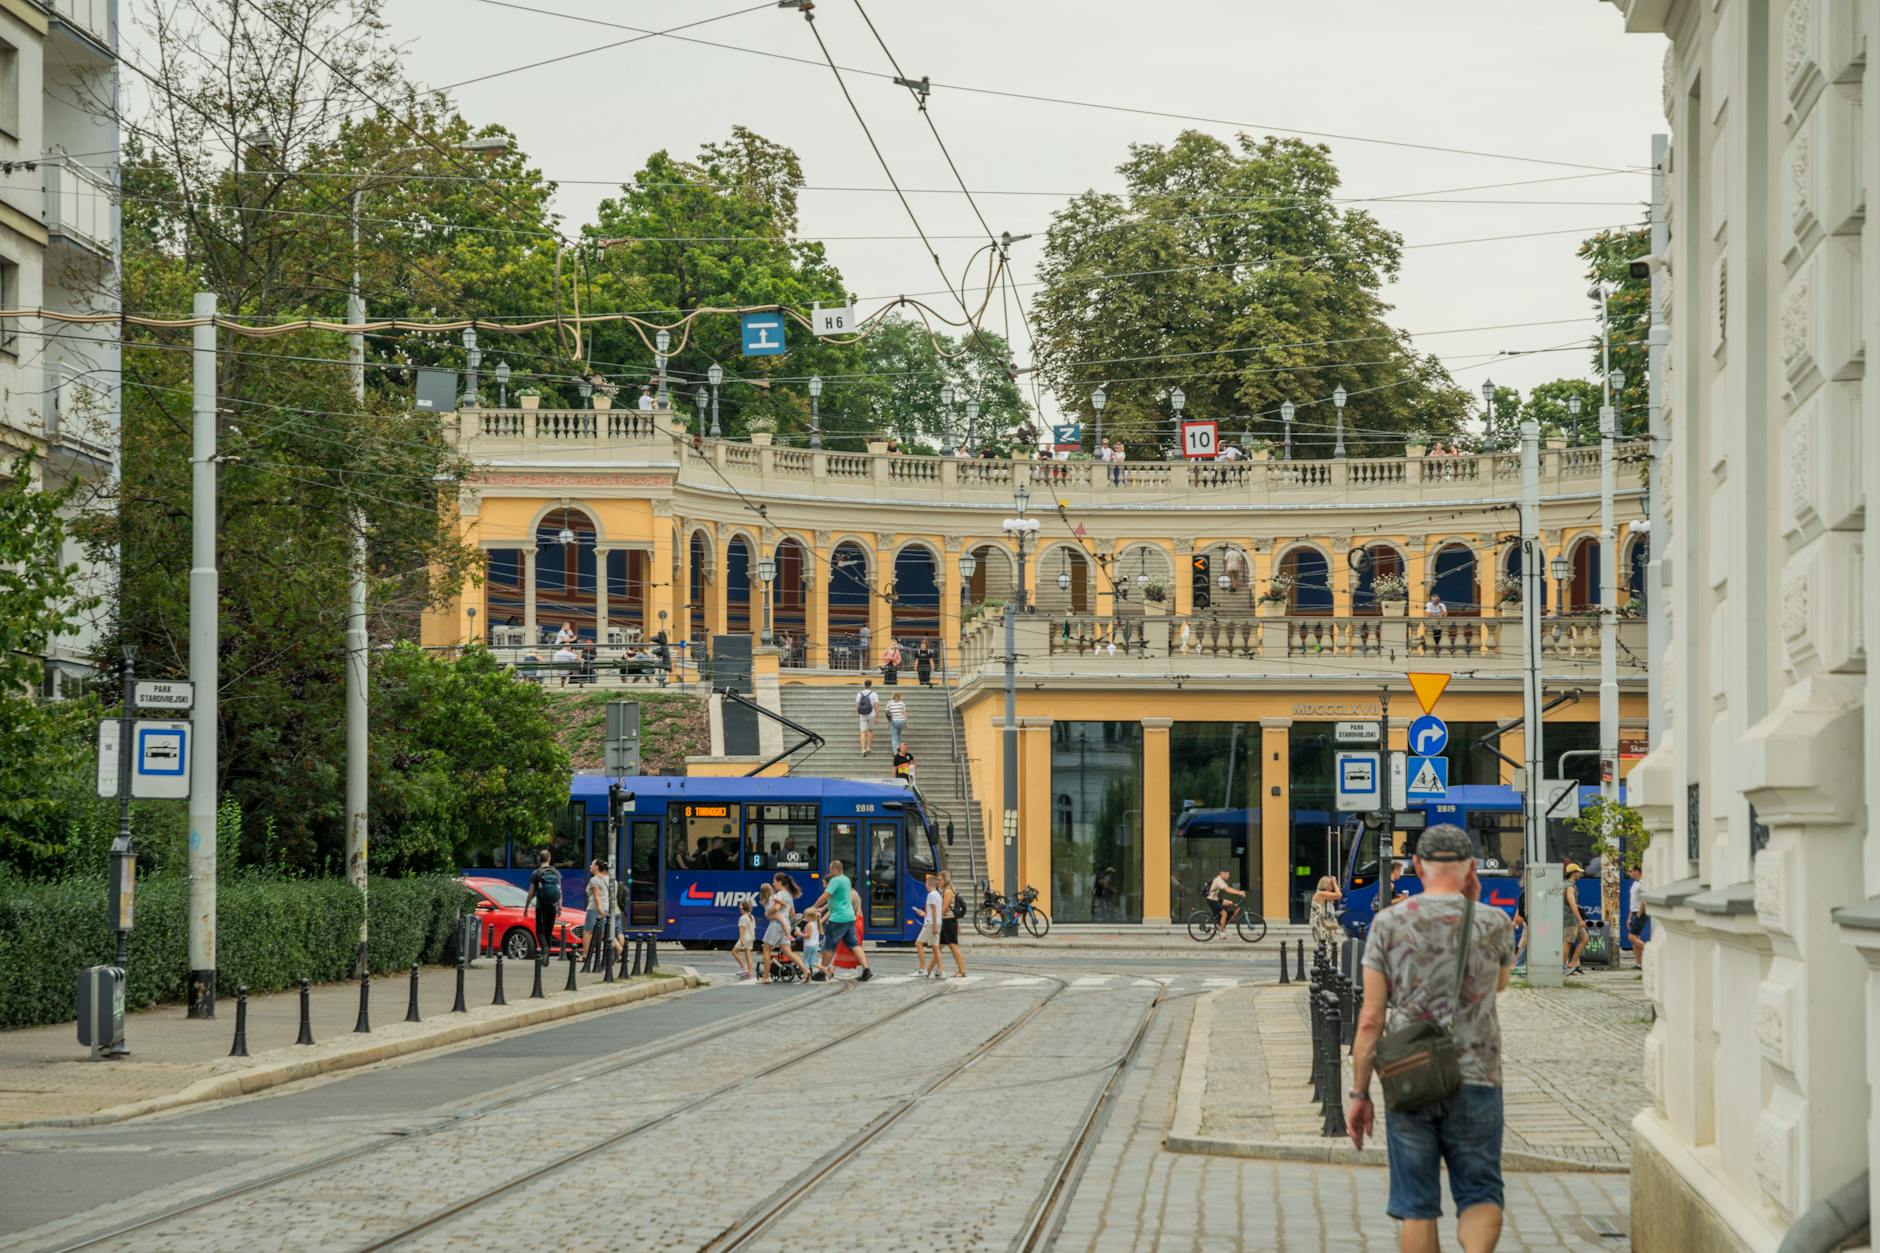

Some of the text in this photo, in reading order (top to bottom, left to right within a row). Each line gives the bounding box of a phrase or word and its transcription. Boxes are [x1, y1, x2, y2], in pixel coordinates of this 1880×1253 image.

[825, 316, 844, 330] H 6
[1189, 431, 1210, 449] 10
[153, 685, 172, 693] PARK
[140, 694, 189, 703] STAROMIEJSKI
[684, 806, 692, 817] 8
[855, 804, 875, 813] 2818
[1436, 804, 1456, 813] 2819
[753, 854, 761, 867] 8
[714, 891, 760, 907] MPK
